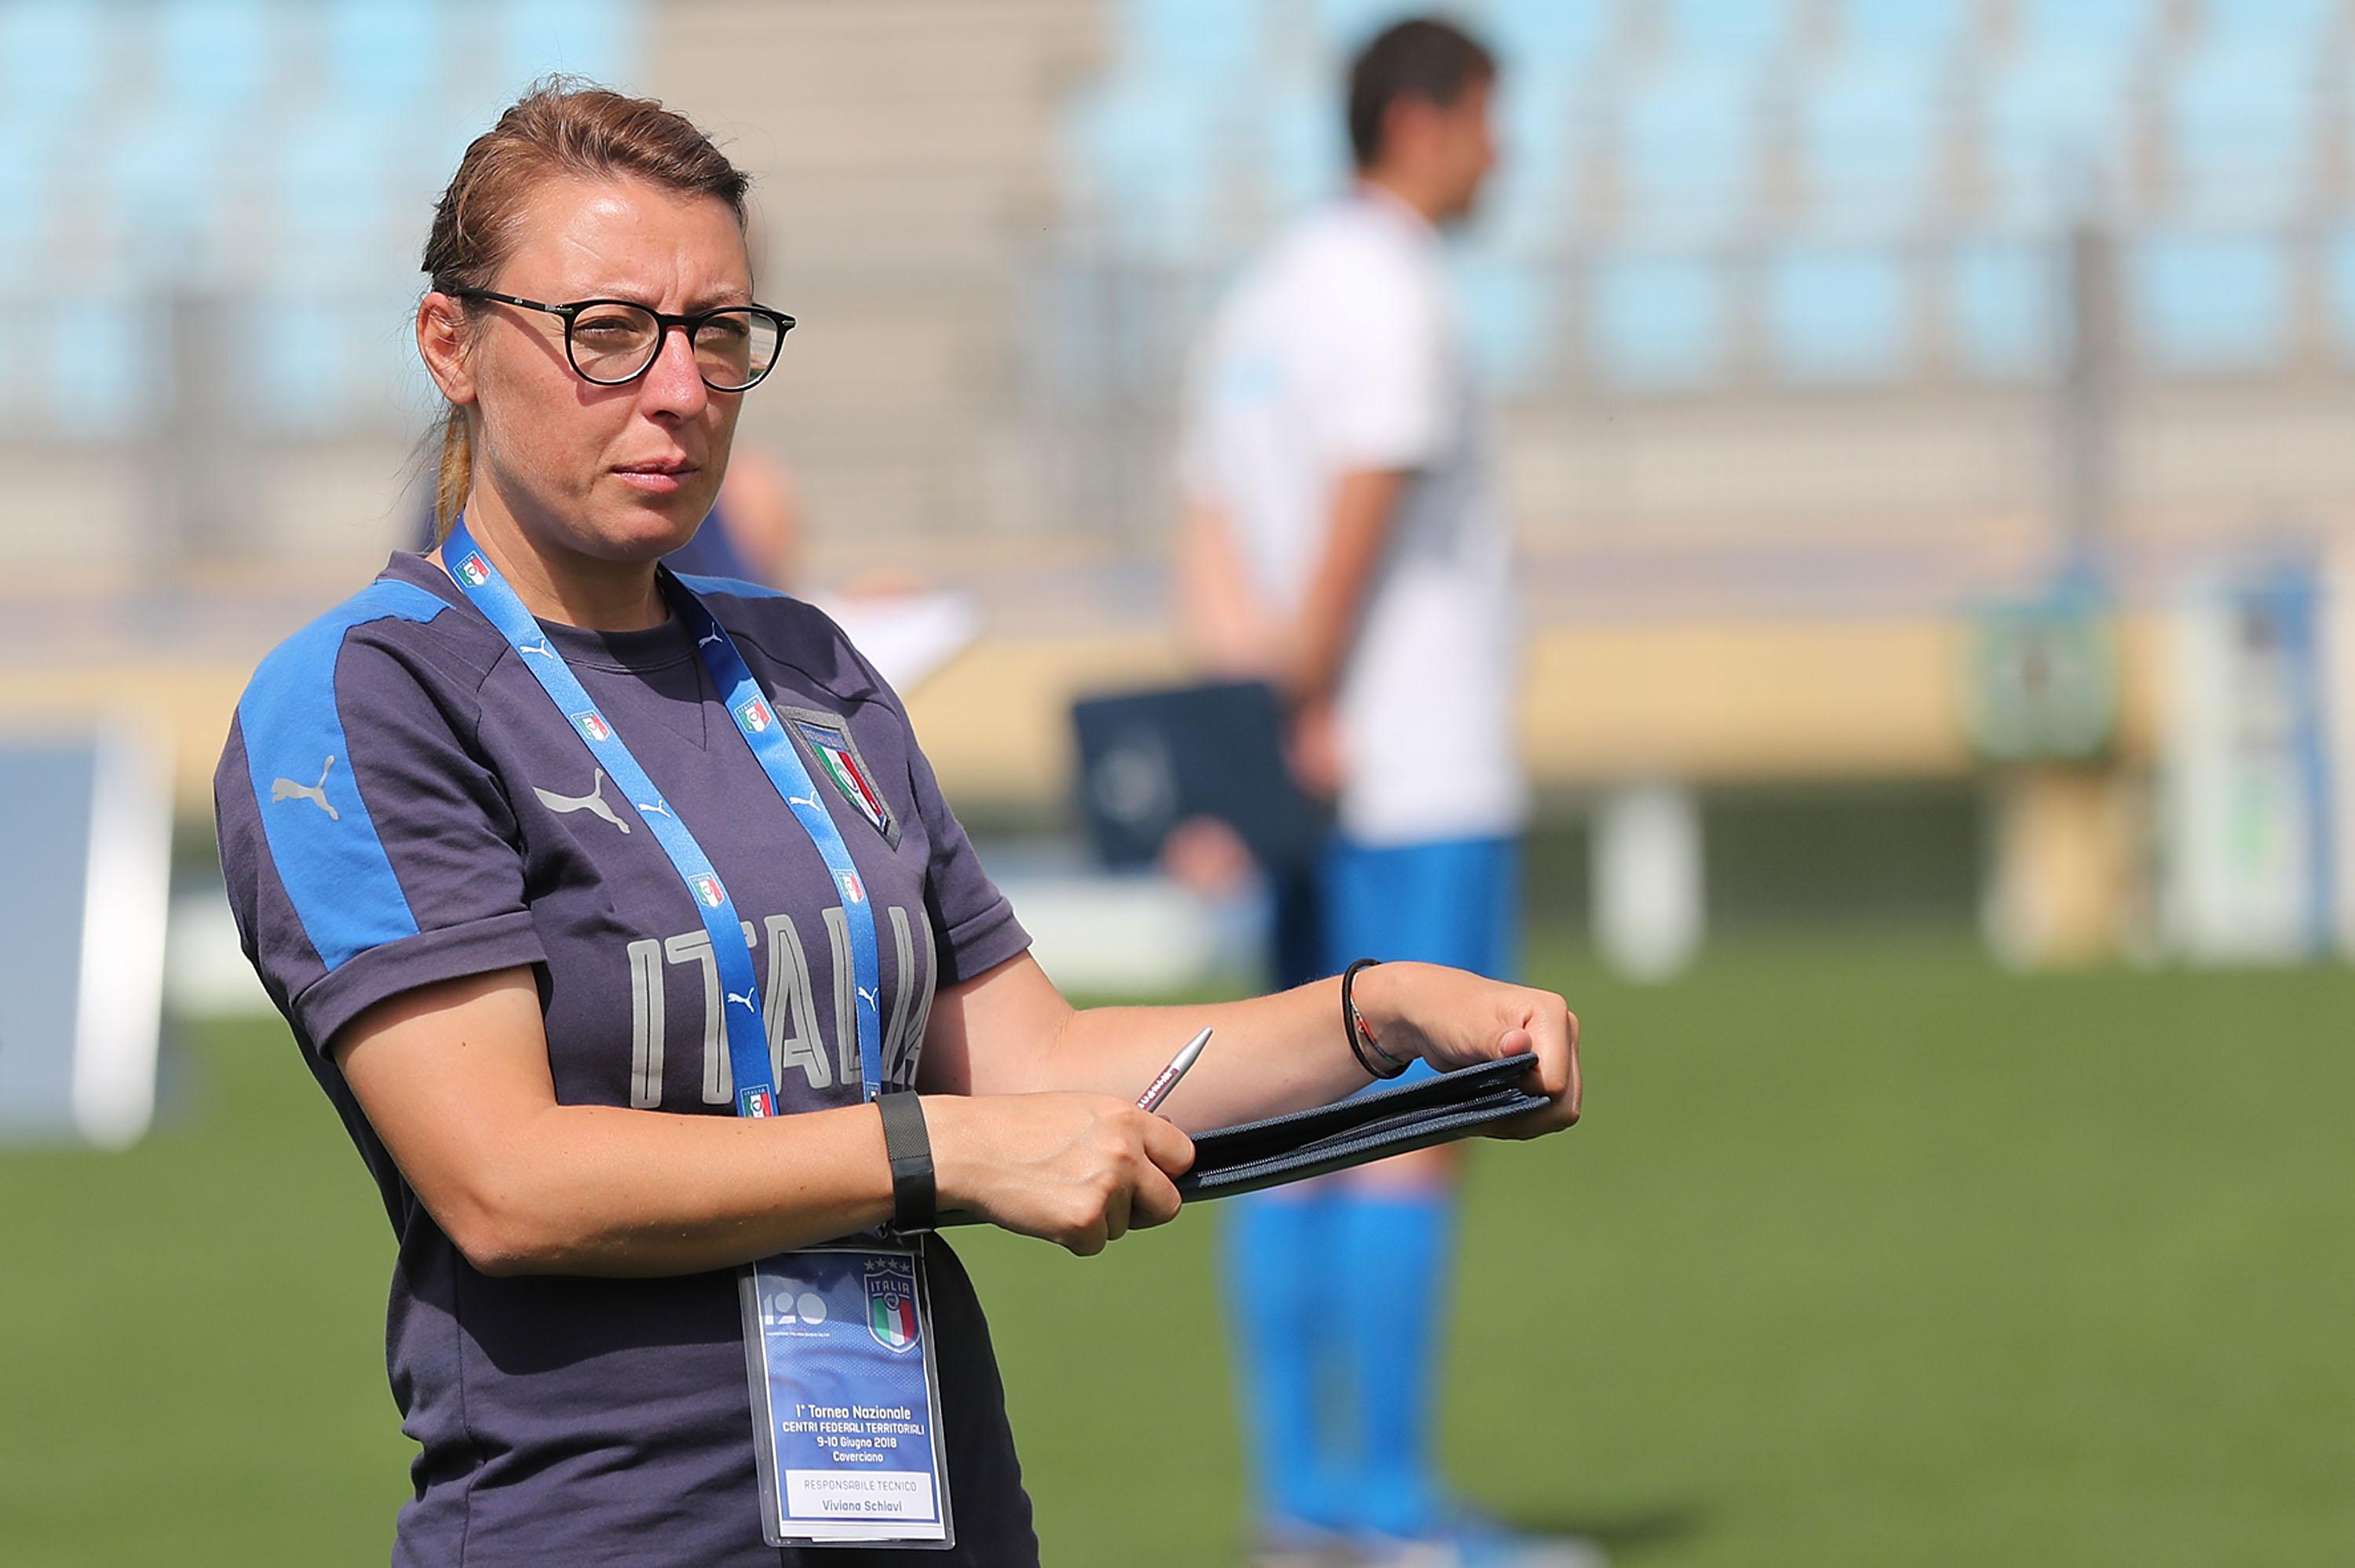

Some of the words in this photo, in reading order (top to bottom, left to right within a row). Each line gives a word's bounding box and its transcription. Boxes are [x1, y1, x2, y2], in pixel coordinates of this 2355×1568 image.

[871, 1280, 910, 1294] ITALIA
[764, 1292, 827, 1326] 120
[808, 1404, 849, 1419] Torneo
[853, 1405, 911, 1420] Nazionale
[782, 1421, 818, 1432] CENTRI
[820, 1422, 864, 1434] FEDERALI
[865, 1422, 925, 1435] TERRITORIALI
[816, 1435, 838, 1447] 9-10
[840, 1436, 872, 1449] Giugno
[874, 1437, 897, 1448] 2018
[833, 1450, 884, 1462] Coverciano
[804, 1479, 874, 1490] RESPONSABILE
[878, 1480, 917, 1491] TECNICO
[822, 1500, 861, 1511] Viviana
[864, 1501, 902, 1511] Schiavi
